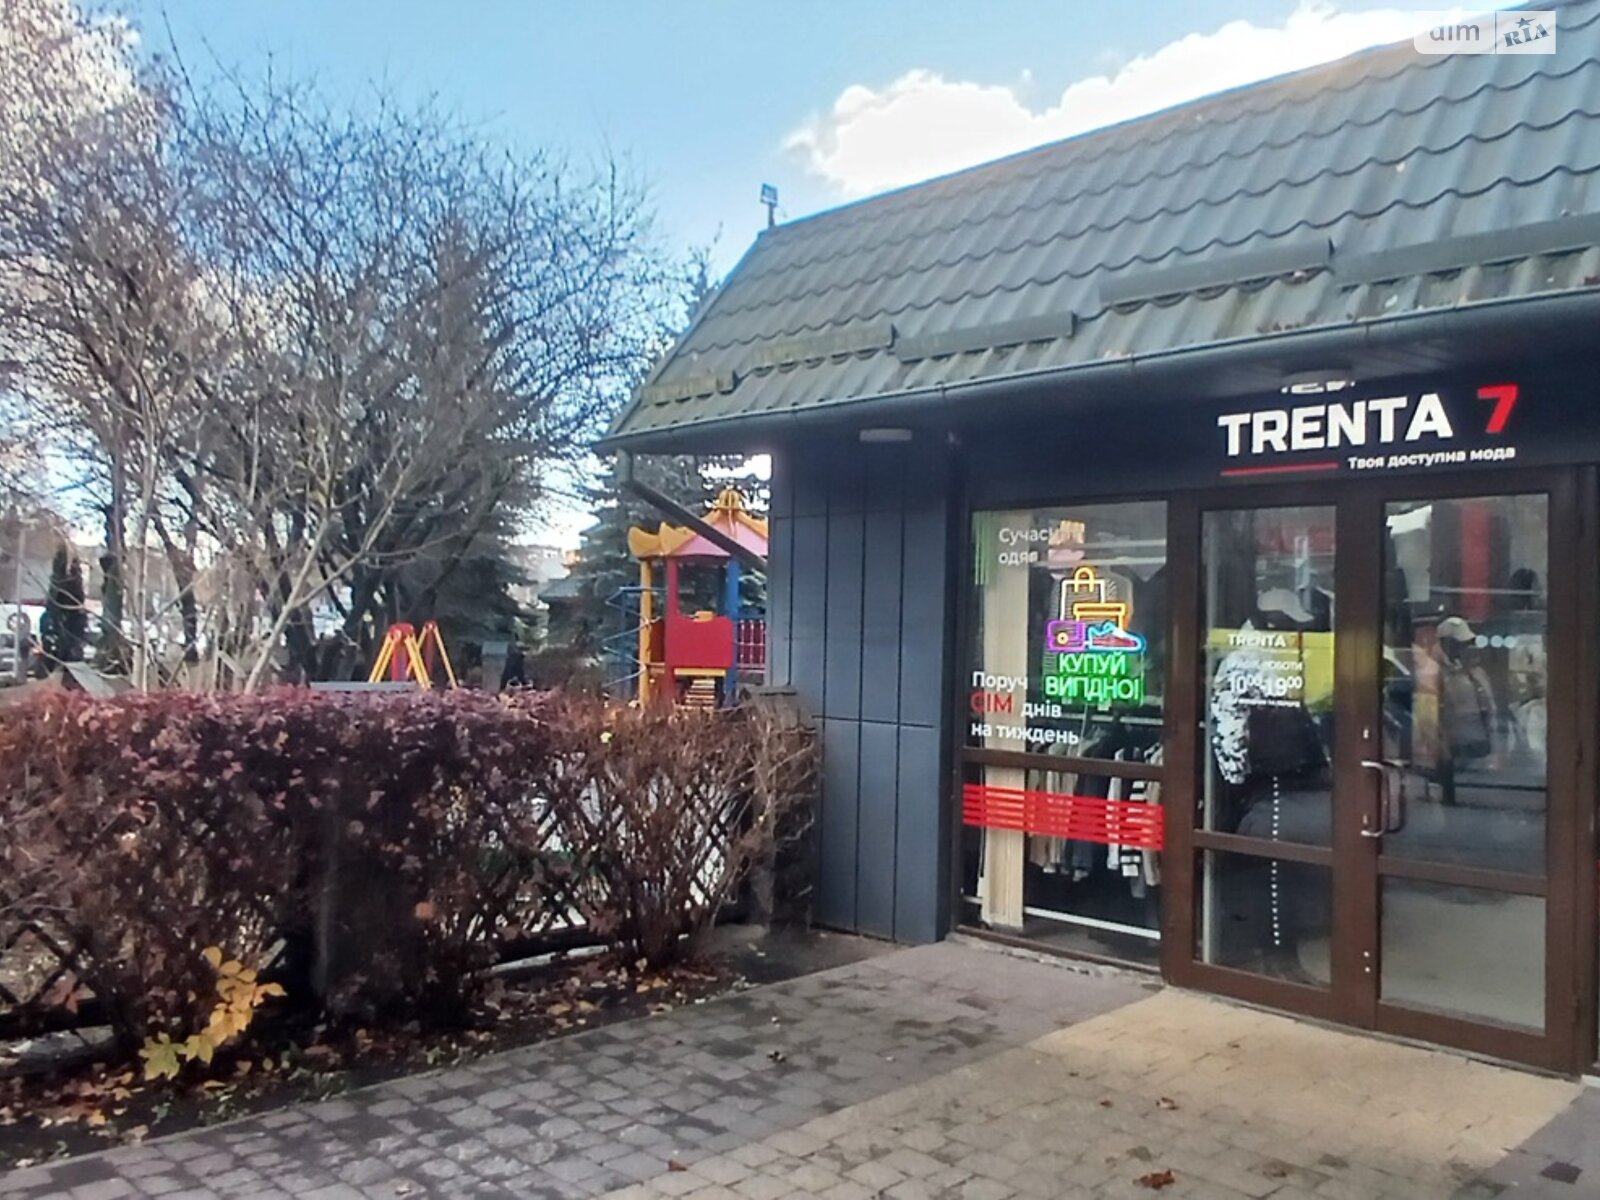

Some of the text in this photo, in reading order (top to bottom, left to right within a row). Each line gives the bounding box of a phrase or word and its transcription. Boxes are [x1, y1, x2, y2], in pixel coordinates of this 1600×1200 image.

[1217, 384, 1519, 456] TRENTA 7
[1348, 447, 1516, 469] Твоя доступна мода
[998, 527, 1077, 546] Сучас
[1059, 651, 1126, 675] КУПУЙ
[972, 671, 1028, 692] Поруч
[970, 691, 1062, 719] СІМ днів
[971, 723, 1080, 745] на тиждень
